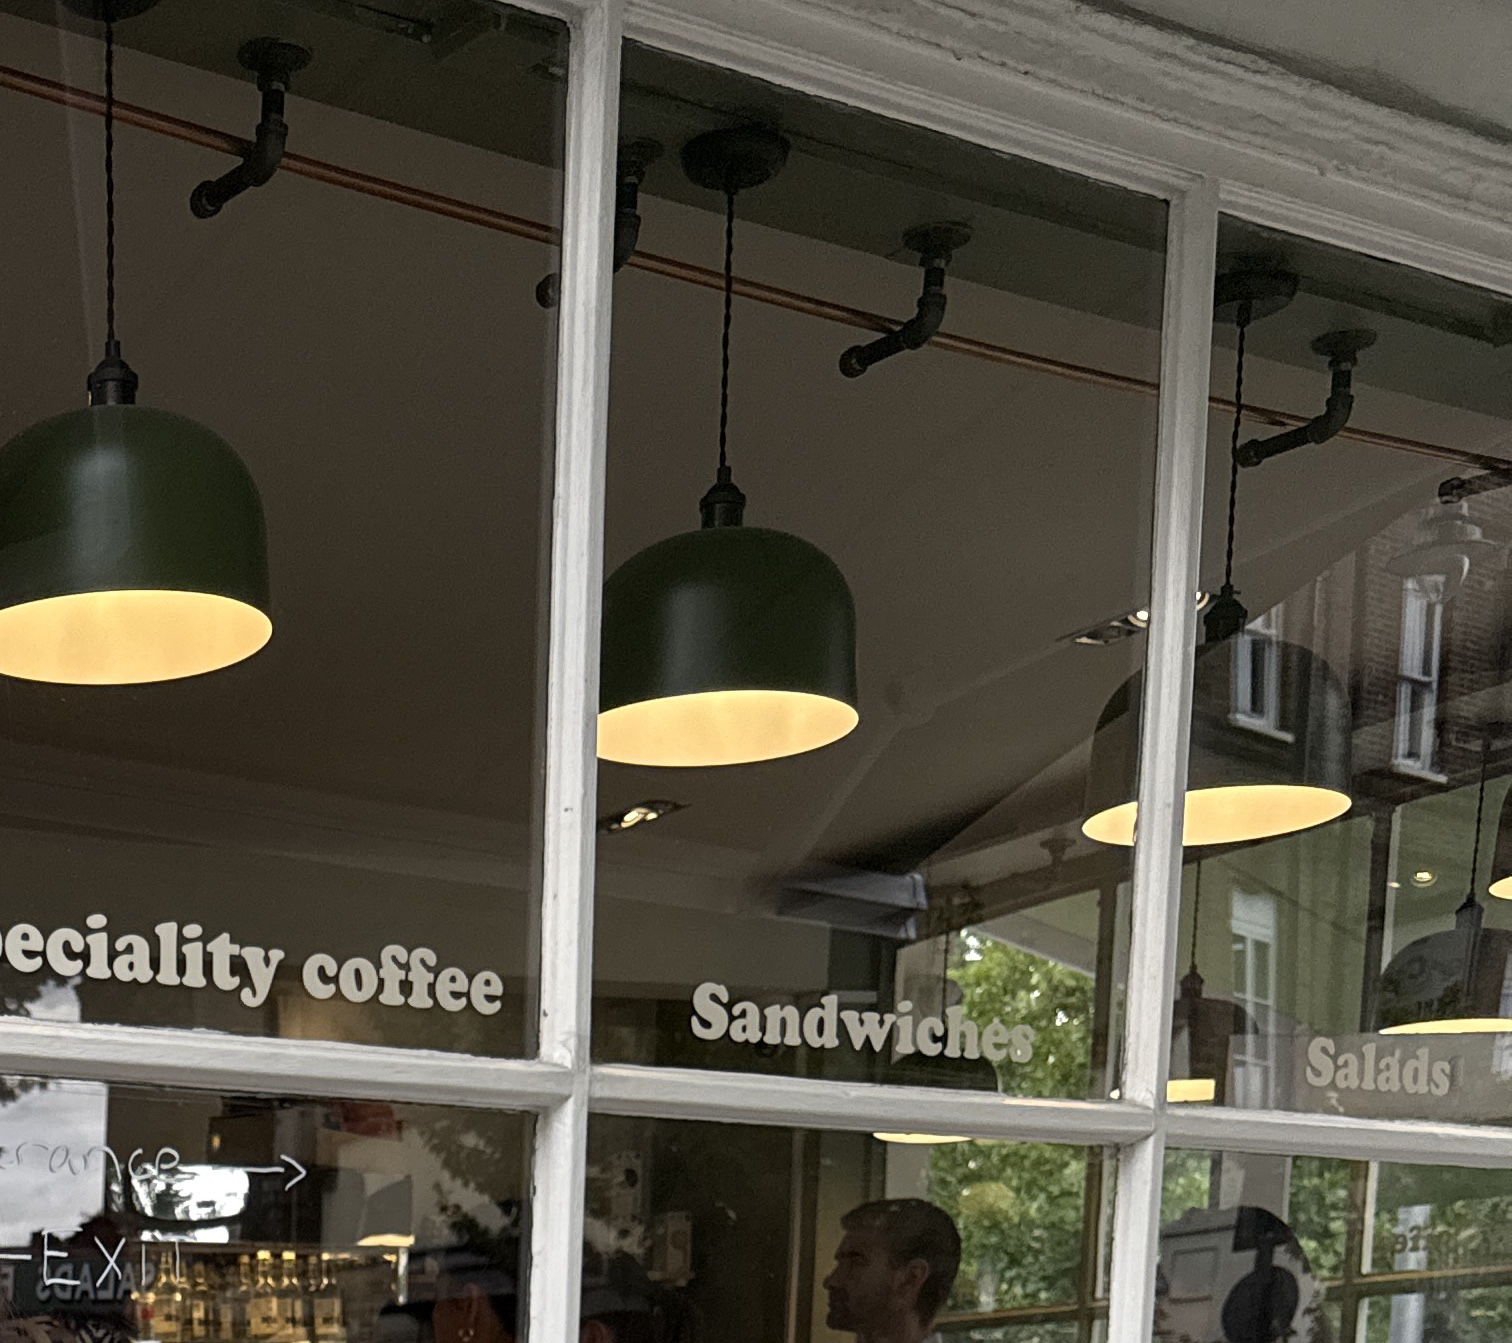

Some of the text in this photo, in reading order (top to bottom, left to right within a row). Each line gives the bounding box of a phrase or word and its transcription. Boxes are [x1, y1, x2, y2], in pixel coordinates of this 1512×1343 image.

[301, 944, 505, 1016] coffee
[690, 982, 1035, 1064] Sandwiches
[1304, 1036, 1451, 1097] Salads
